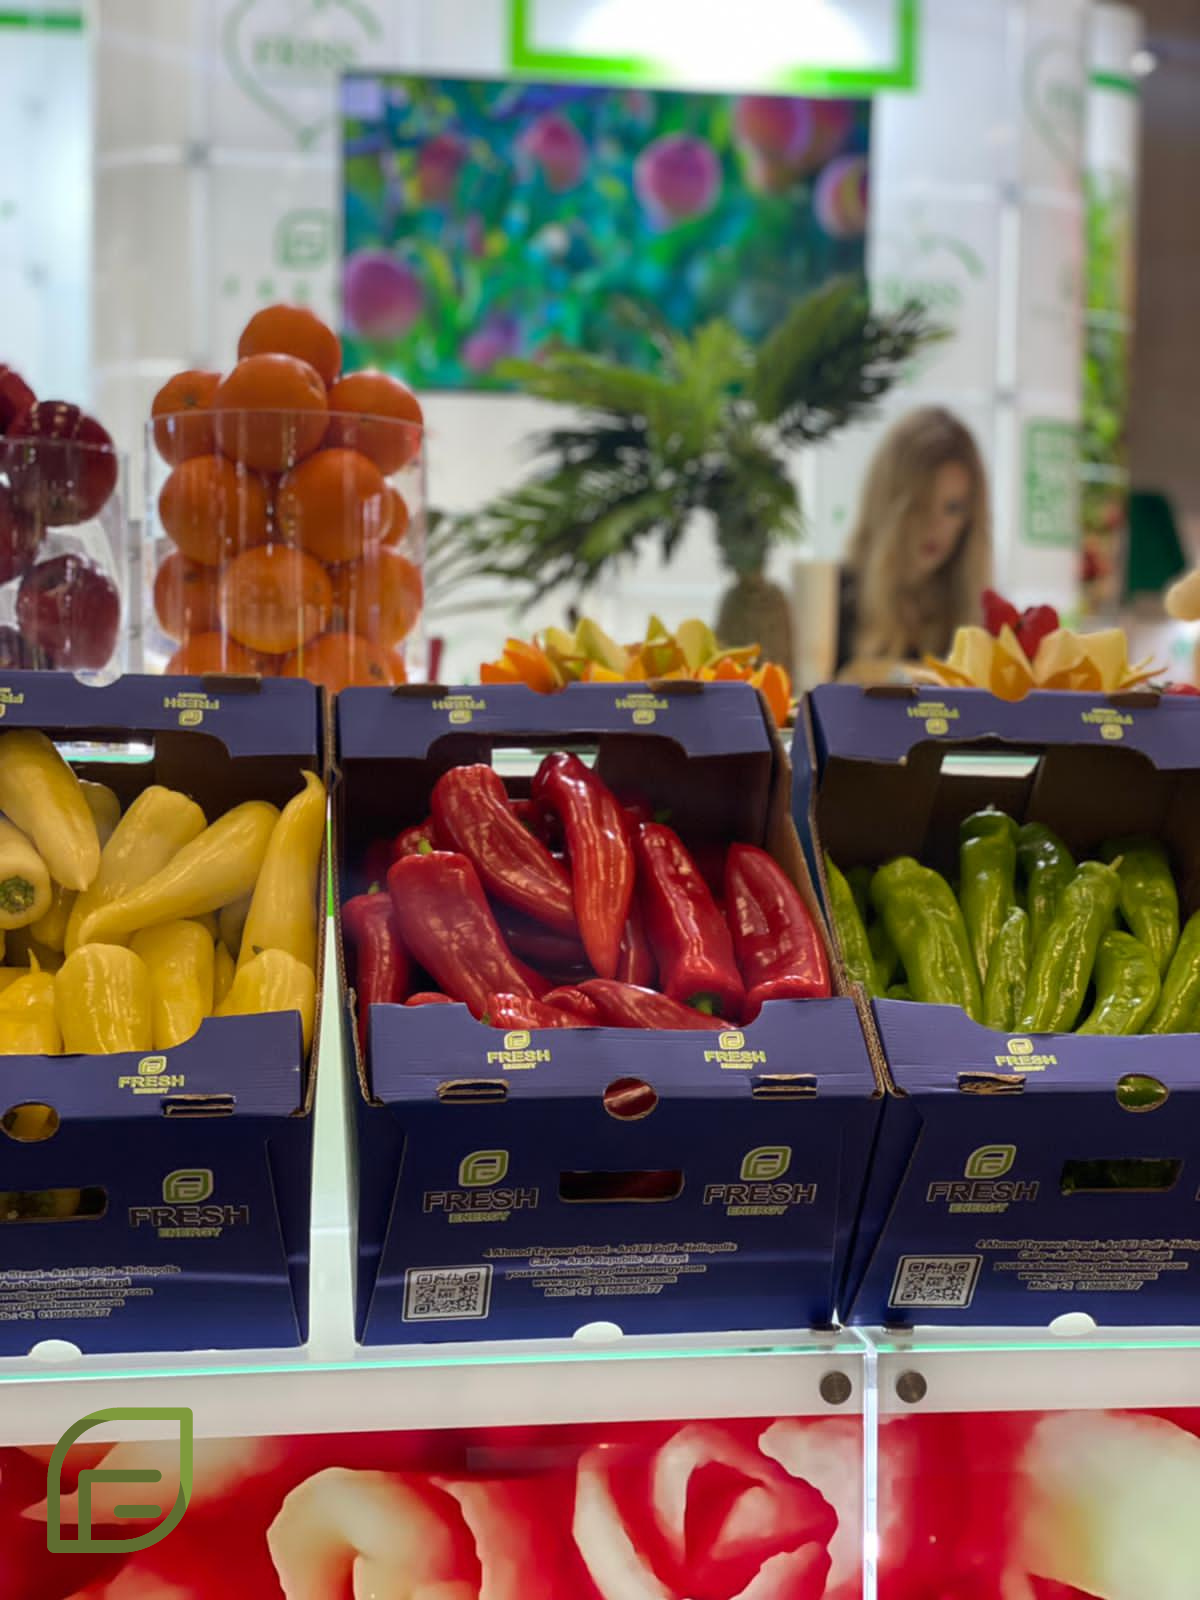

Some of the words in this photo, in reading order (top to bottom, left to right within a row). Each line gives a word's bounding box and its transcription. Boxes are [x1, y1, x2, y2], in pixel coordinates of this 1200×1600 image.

[487, 1049, 551, 1064] FRESH
[704, 1050, 767, 1063] FRESH
[995, 1055, 1058, 1067] FRESH
[118, 1074, 185, 1088] FRESH
[703, 1183, 817, 1205] FRESH
[926, 1180, 1040, 1202] FRESH
[423, 1187, 540, 1213] FRESH
[128, 1205, 250, 1227] FRESH
[448, 1211, 511, 1223] ENERGY
[727, 1205, 788, 1216] ENERGY
